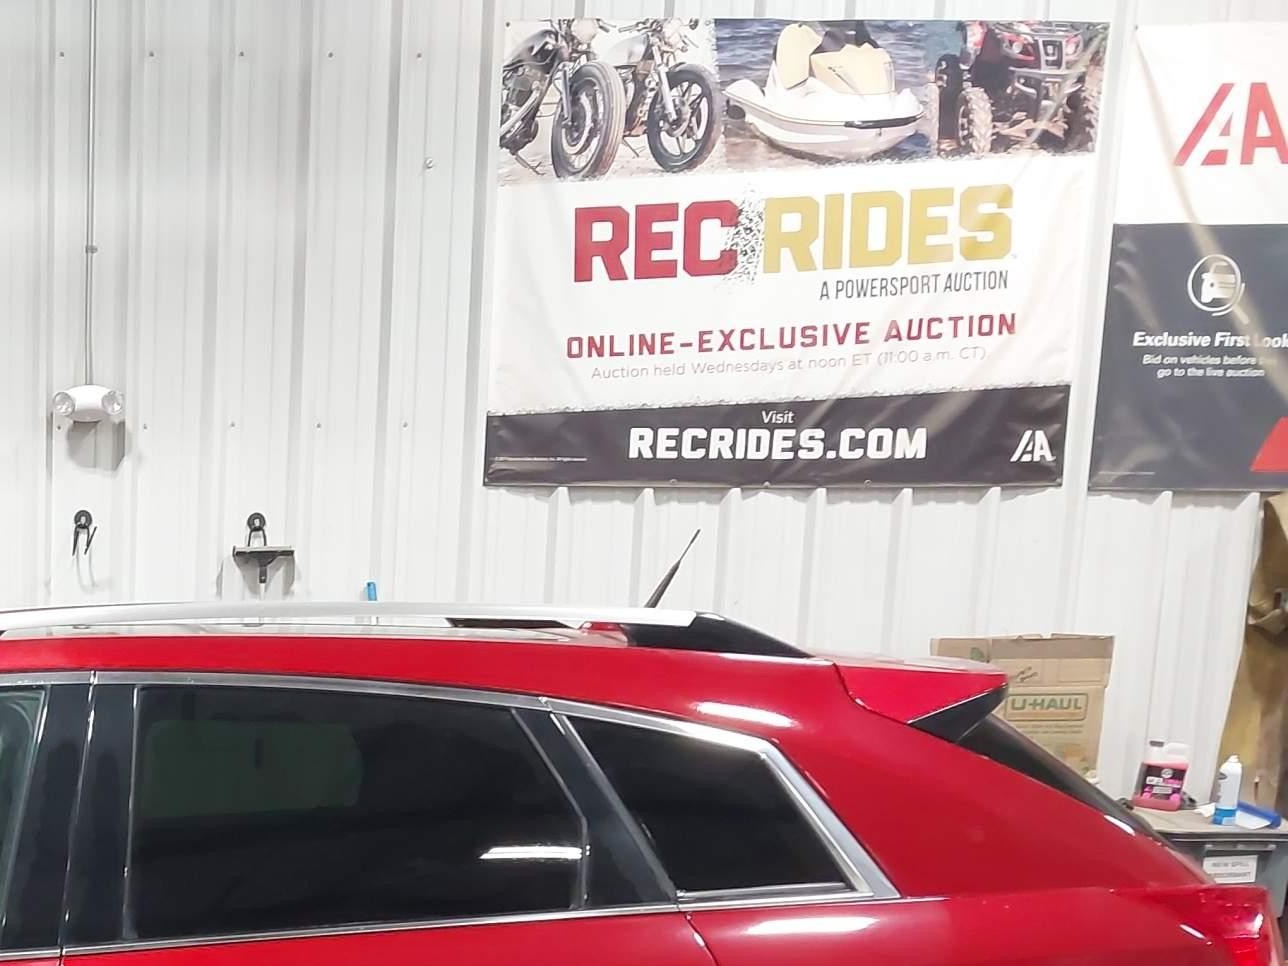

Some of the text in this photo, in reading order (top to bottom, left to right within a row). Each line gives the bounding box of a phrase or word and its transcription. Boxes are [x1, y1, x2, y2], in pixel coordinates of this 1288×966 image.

[574, 183, 1013, 282] REC RIDES
[819, 270, 1009, 300] A POWERSPORT AUCTION
[566, 312, 1017, 359] ONLINE-EXCLUSIVE AUCTION
[1132, 331, 1212, 347] Exclusive
[1214, 331, 1251, 347] First
[591, 365, 649, 380] Auction
[653, 363, 686, 377] held
[691, 359, 784, 377] Wednesdays
[787, 358, 803, 371] at
[808, 356, 847, 369] noon
[852, 352, 872, 367] ET
[922, 350, 953, 363] a.m.
[1142, 354, 1162, 365] Bid
[761, 409, 795, 424] Visit
[628, 426, 928, 460] RECRIDES.COM
[1010, 697, 1082, 711] U-HAUL
